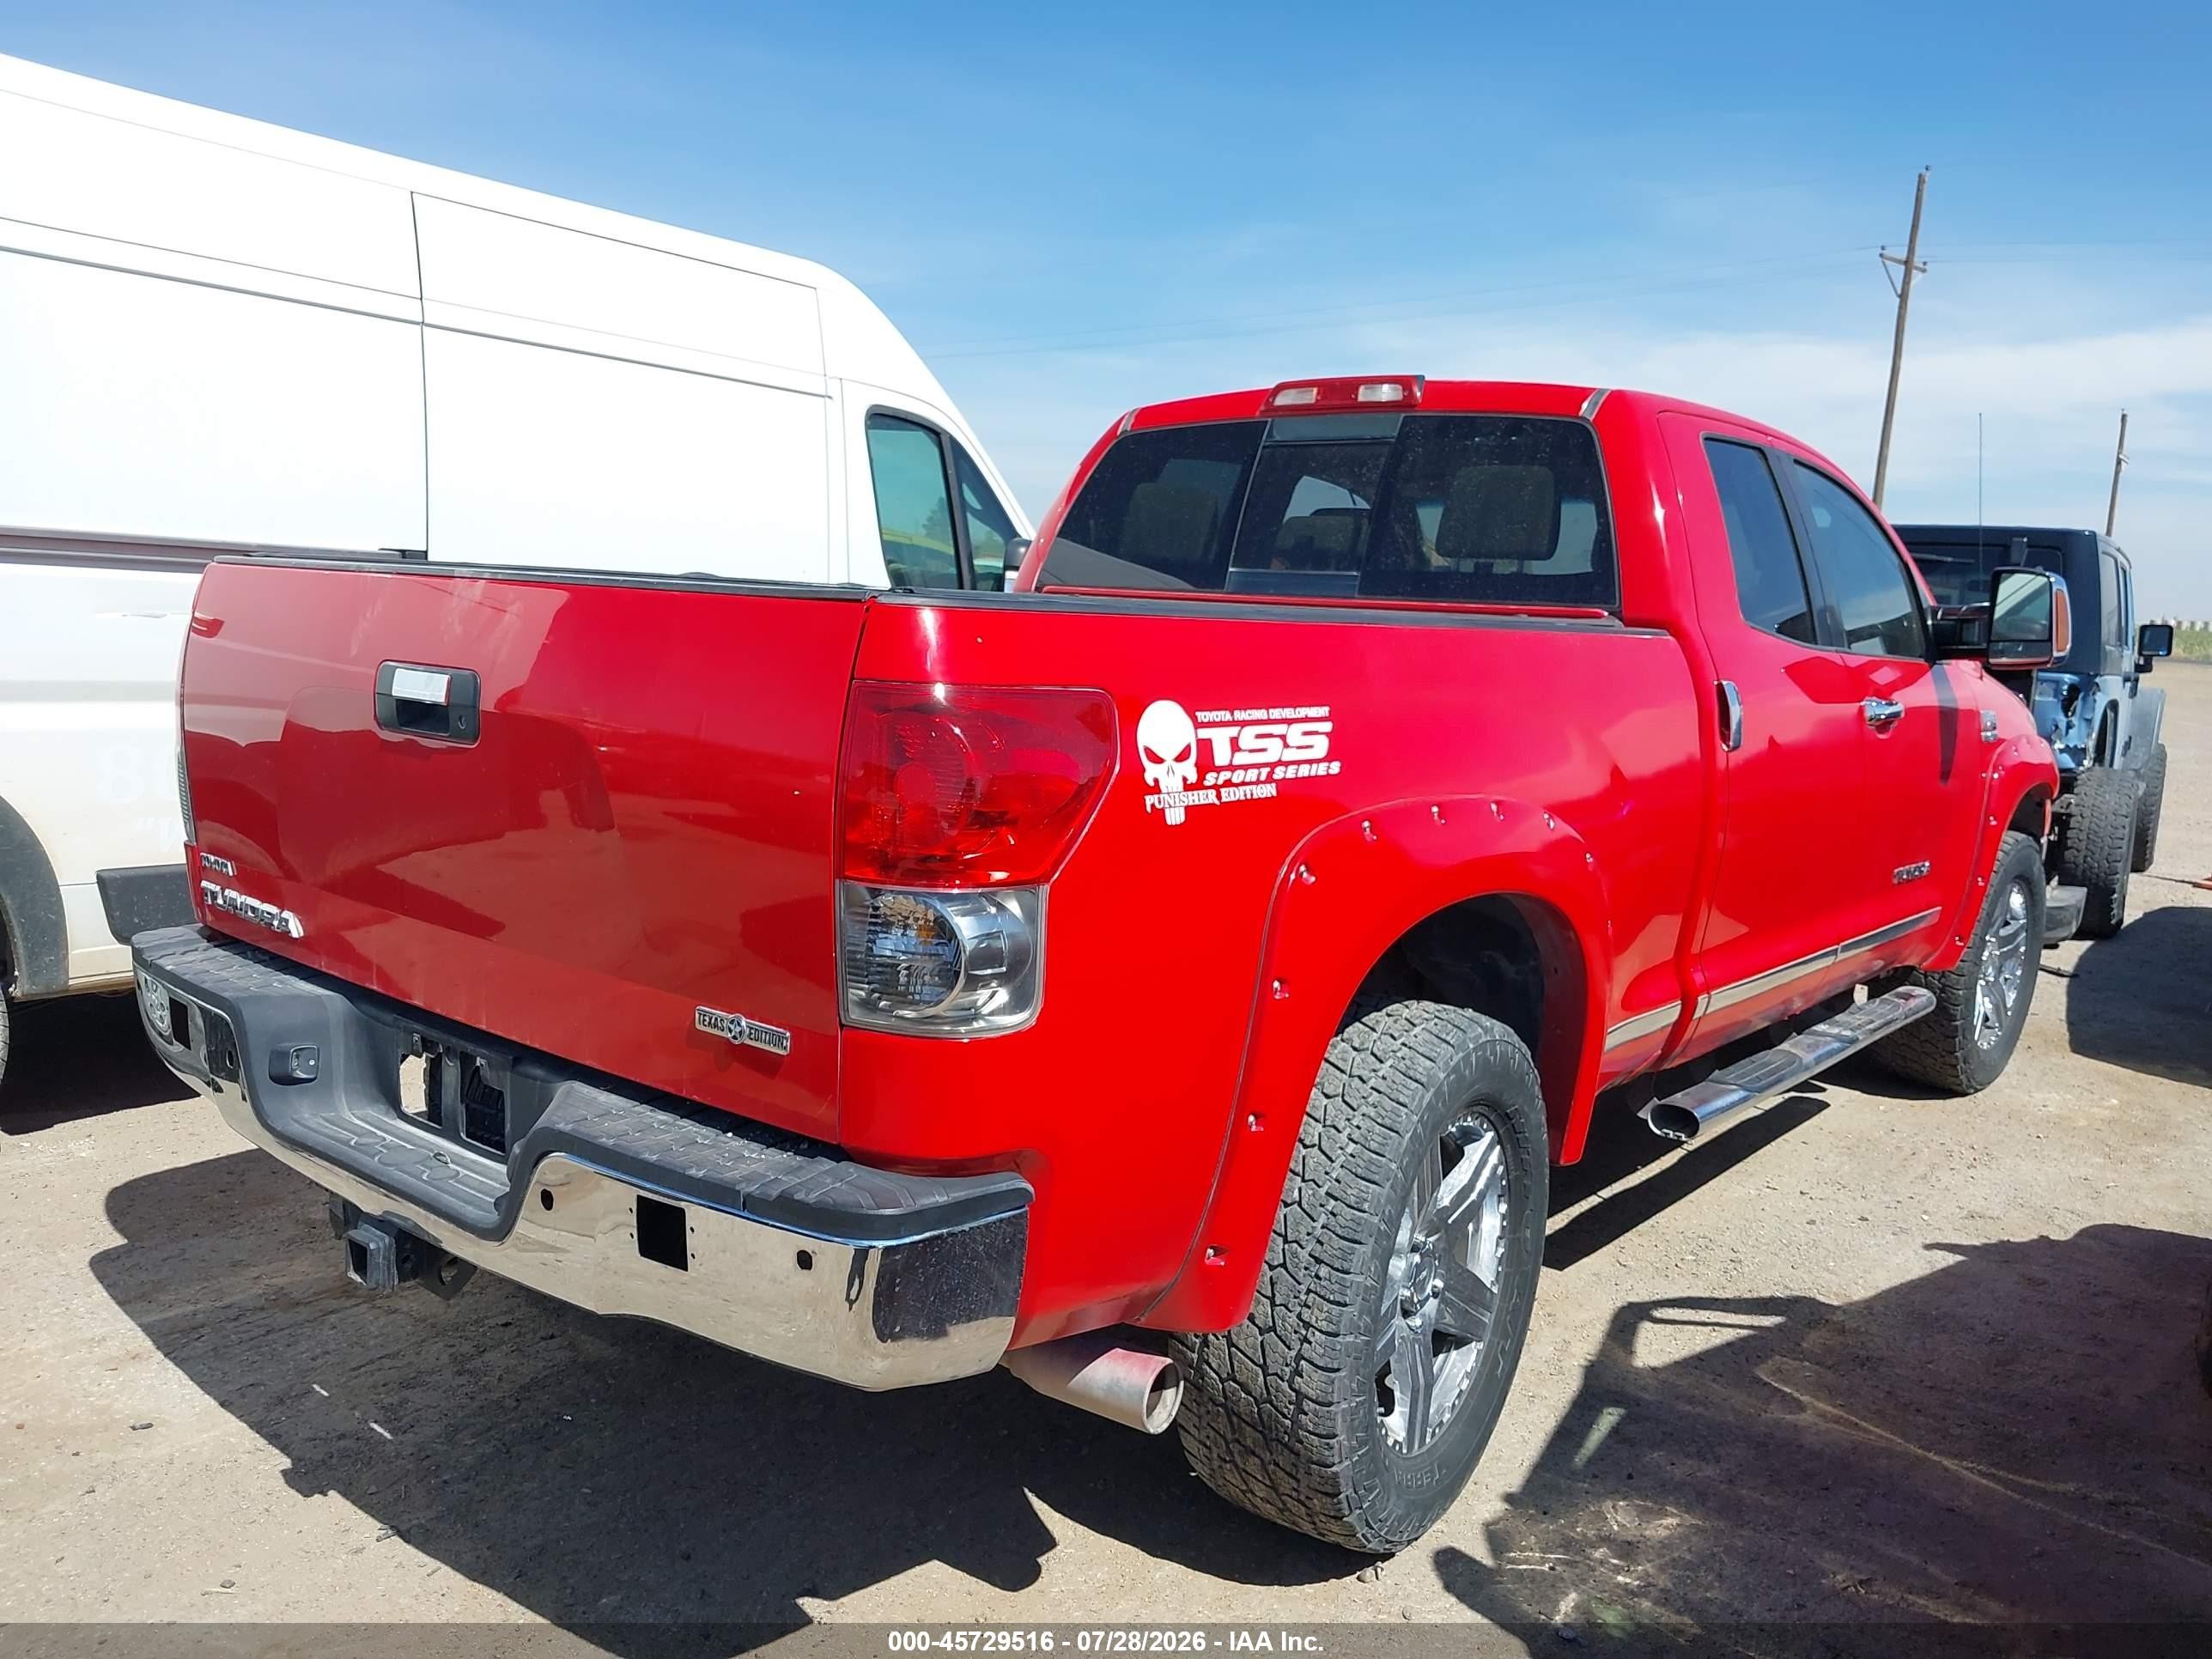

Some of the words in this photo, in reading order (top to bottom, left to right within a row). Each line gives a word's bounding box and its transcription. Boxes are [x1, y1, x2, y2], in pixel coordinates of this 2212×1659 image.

[1195, 711, 1232, 722] TOYOTA
[1234, 709, 1267, 721] RACING
[1268, 706, 1330, 720] DEVELOPMENT
[1197, 721, 1333, 767] TSS
[1204, 768, 1270, 786] SPORT
[1273, 762, 1340, 780] SERIES
[1145, 789, 1220, 814] PUNISHER
[1221, 783, 1277, 803] EDITION
[201, 880, 304, 939] TUNDRA
[697, 1012, 725, 1032] TEXAS
[748, 1026, 785, 1051] EDITION
